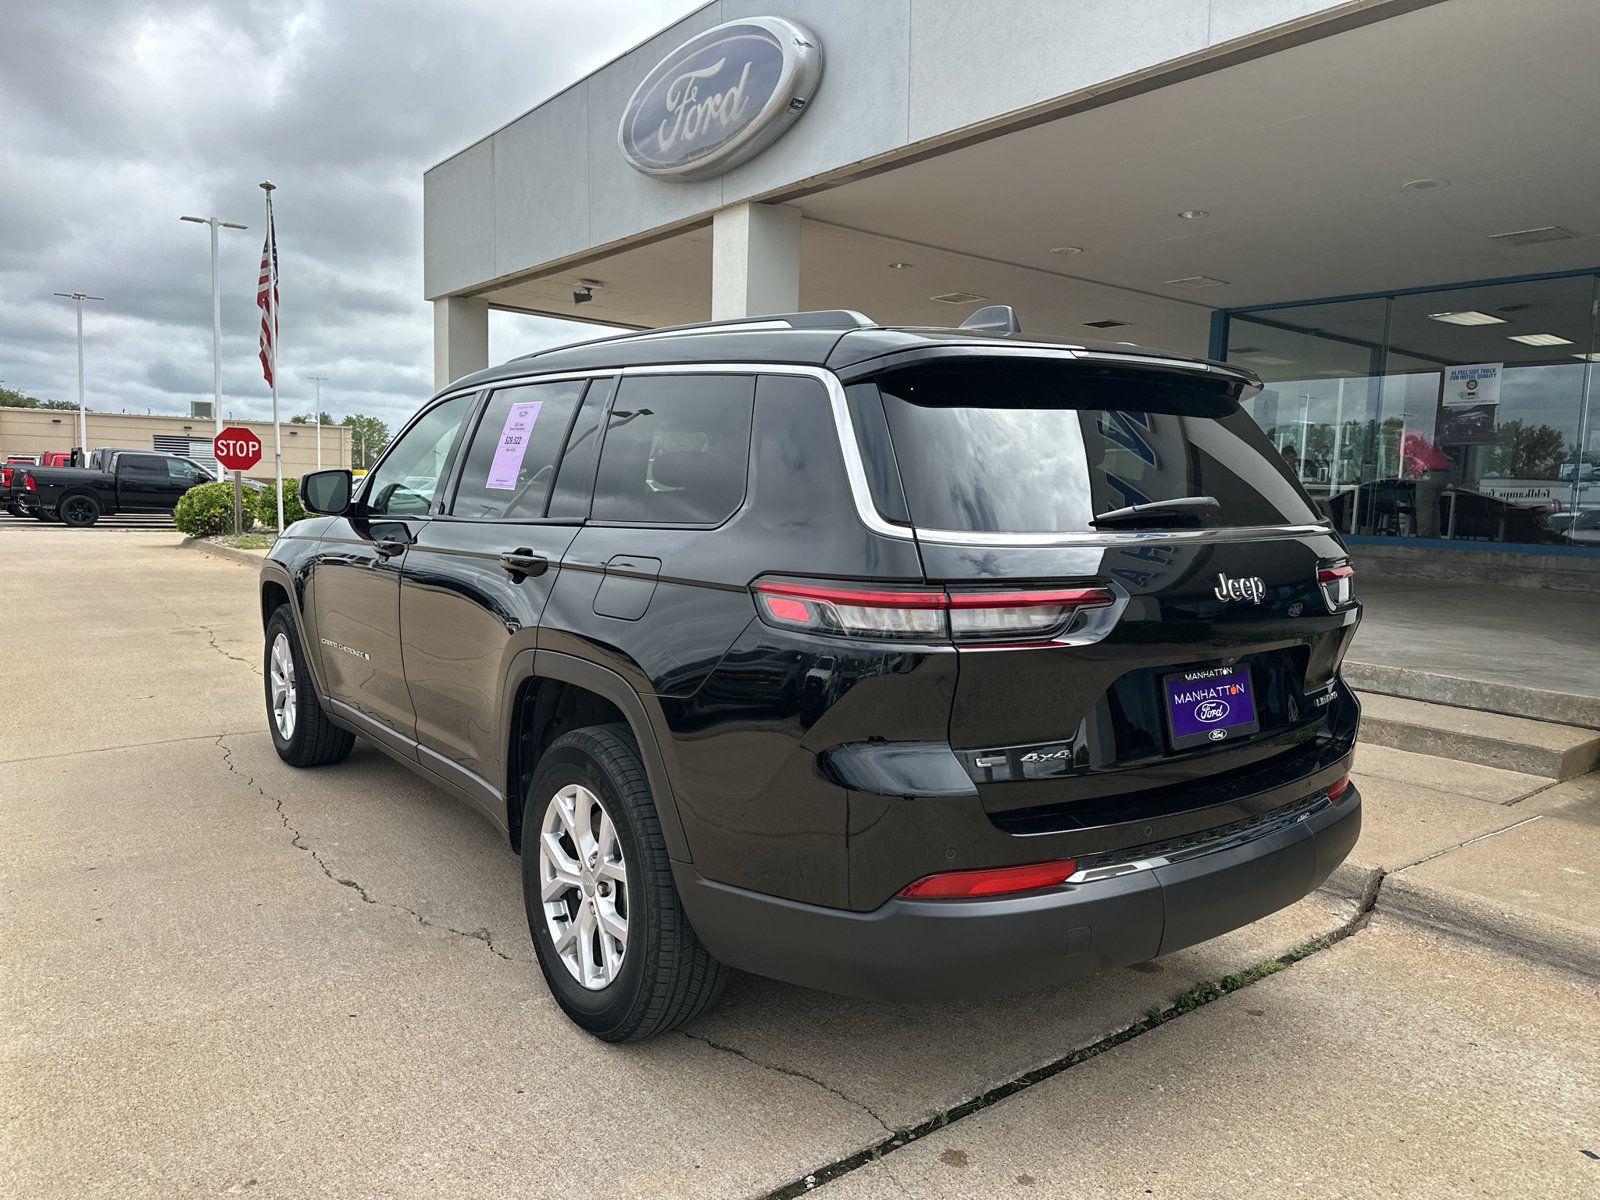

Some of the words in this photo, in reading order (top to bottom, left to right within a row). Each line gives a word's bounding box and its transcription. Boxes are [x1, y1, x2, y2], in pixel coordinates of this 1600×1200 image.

[657, 57, 752, 151] Ford
[217, 439, 260, 458] STOP
[1214, 572, 1267, 605] Jeep
[1200, 703, 1224, 720] Ford
[1020, 749, 1072, 763] 4x4
